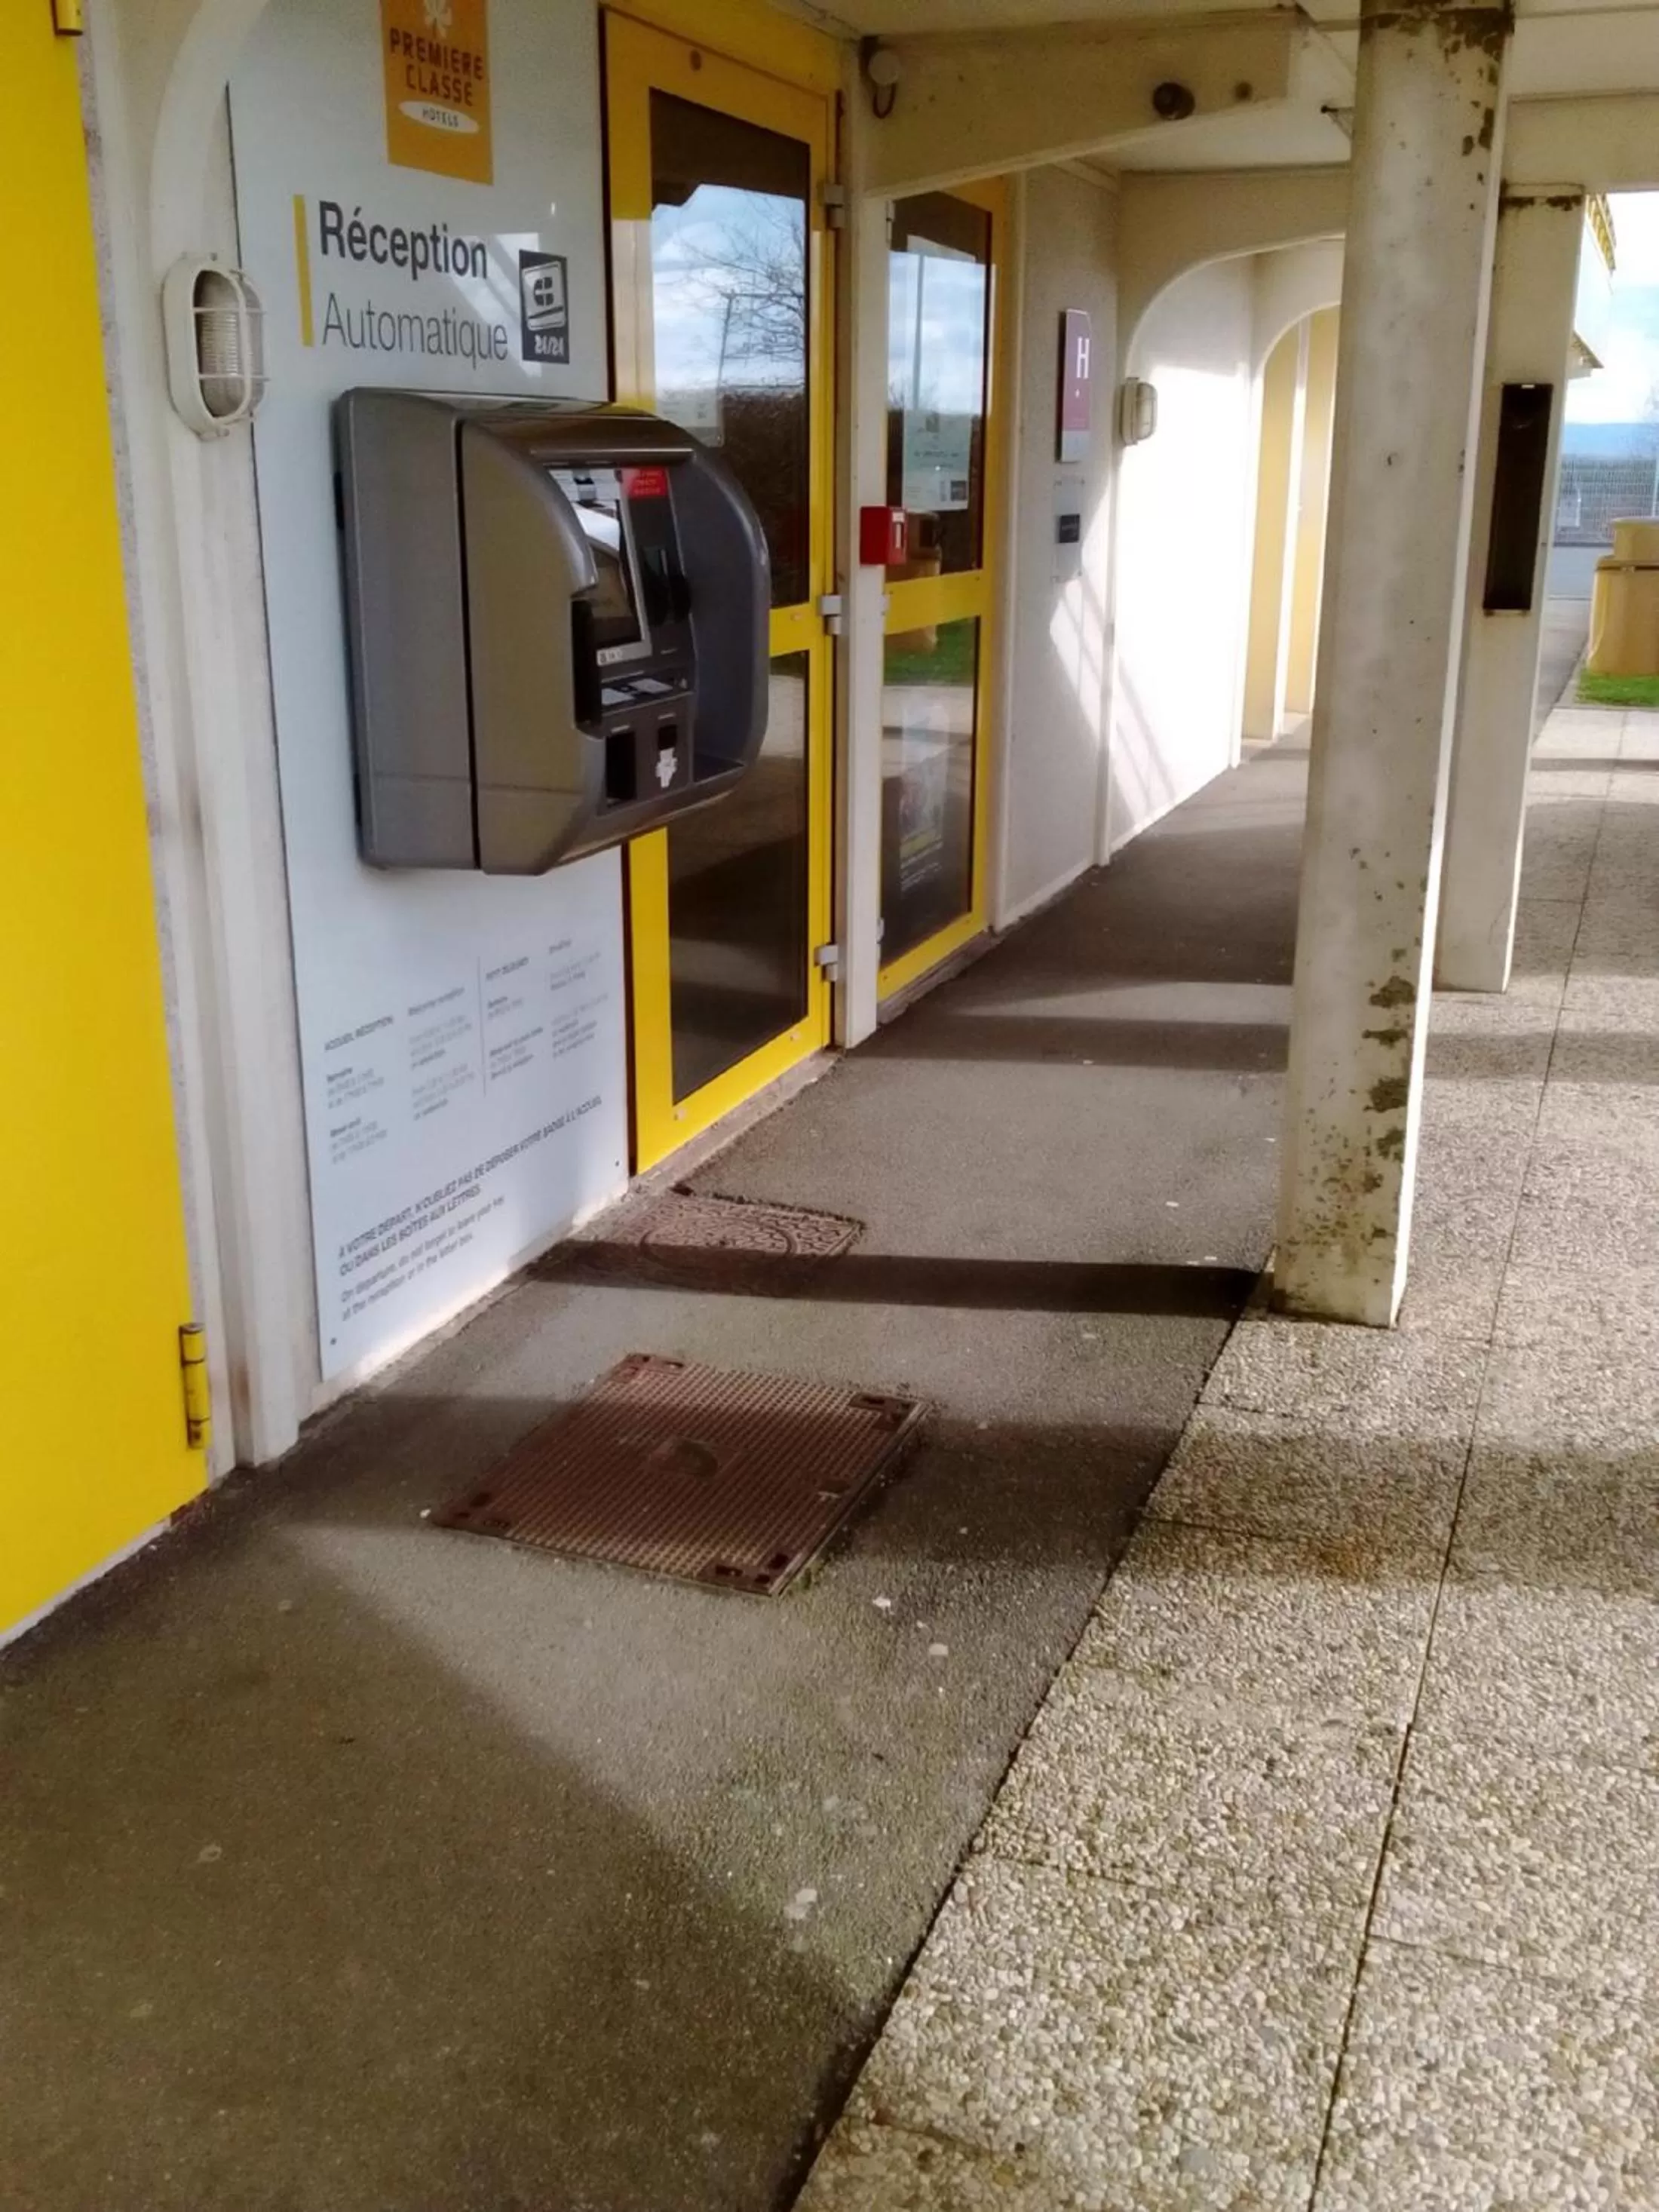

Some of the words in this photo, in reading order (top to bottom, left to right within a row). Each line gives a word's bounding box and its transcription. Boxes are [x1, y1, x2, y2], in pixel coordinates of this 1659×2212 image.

[406, 64, 474, 107] CLASSE
[422, 107, 459, 128] HOTELS
[319, 200, 487, 281] Réception
[322, 293, 508, 370] Automatique
[1076, 336, 1090, 379] H
[340, 1260, 354, 1277] OU
[382, 1232, 397, 1252] LES
